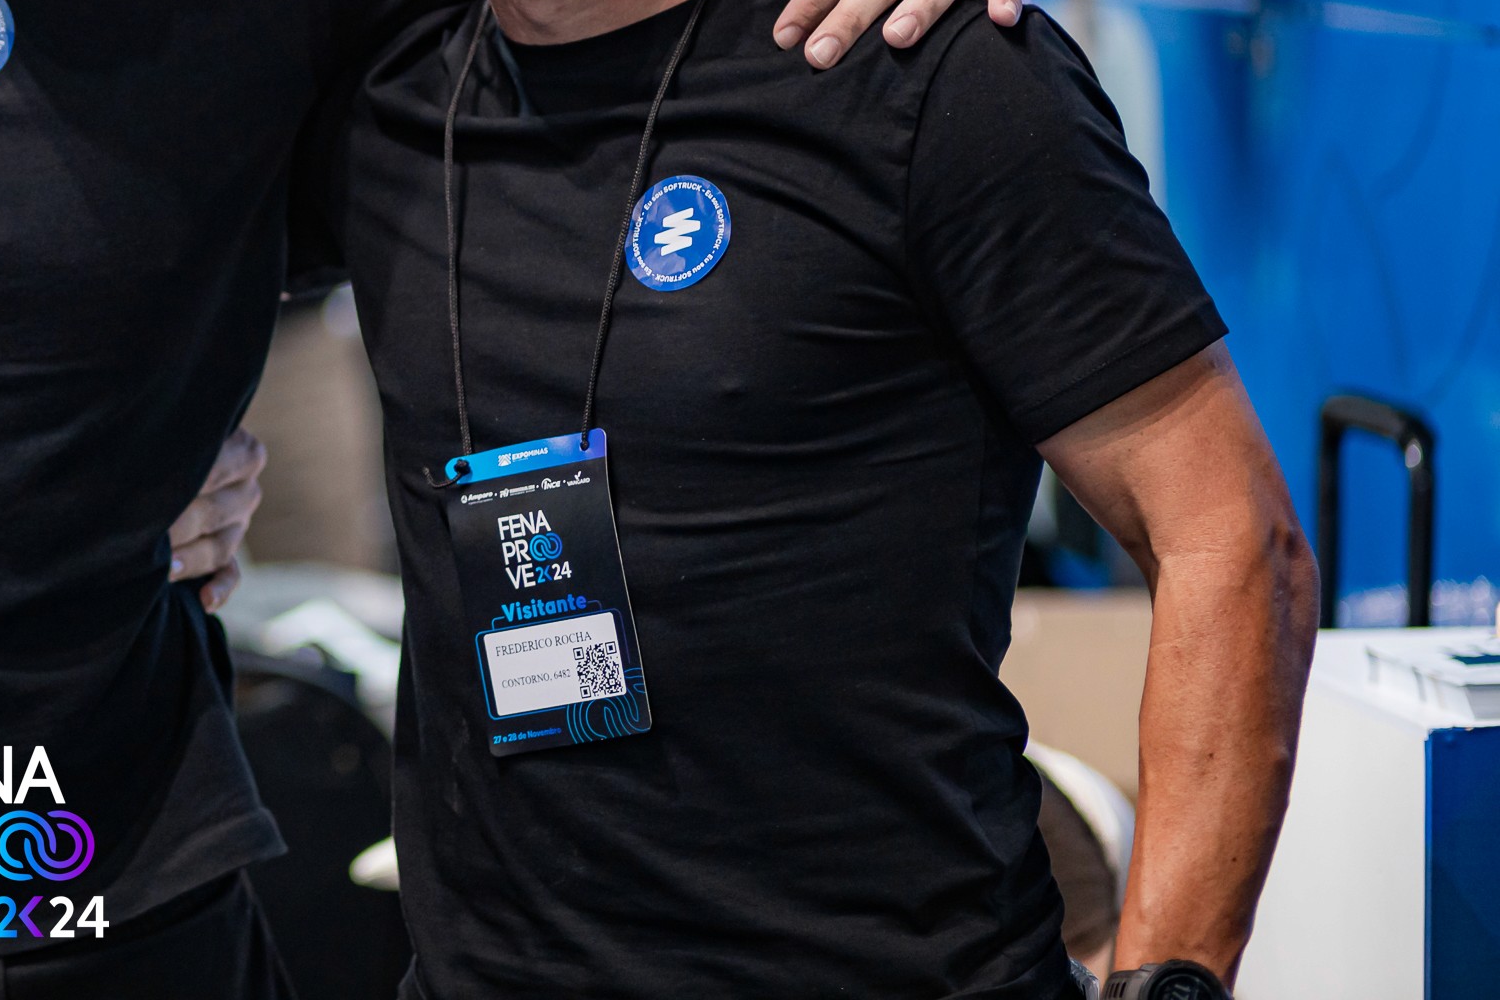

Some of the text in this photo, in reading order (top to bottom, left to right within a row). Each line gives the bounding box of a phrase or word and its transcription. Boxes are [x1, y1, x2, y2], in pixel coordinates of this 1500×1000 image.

[663, 182, 702, 193] SOFTRUCK
[632, 216, 644, 257] SOFTRUCK
[713, 209, 725, 250] SOFTRUCK
[655, 270, 692, 282] SOFTRUCK
[497, 510, 552, 540] FENA
[505, 563, 536, 589] VE
[501, 594, 587, 622] Visitante
[495, 631, 592, 657] FREDERICO ROCHA
[553, 668, 571, 680] 6482
